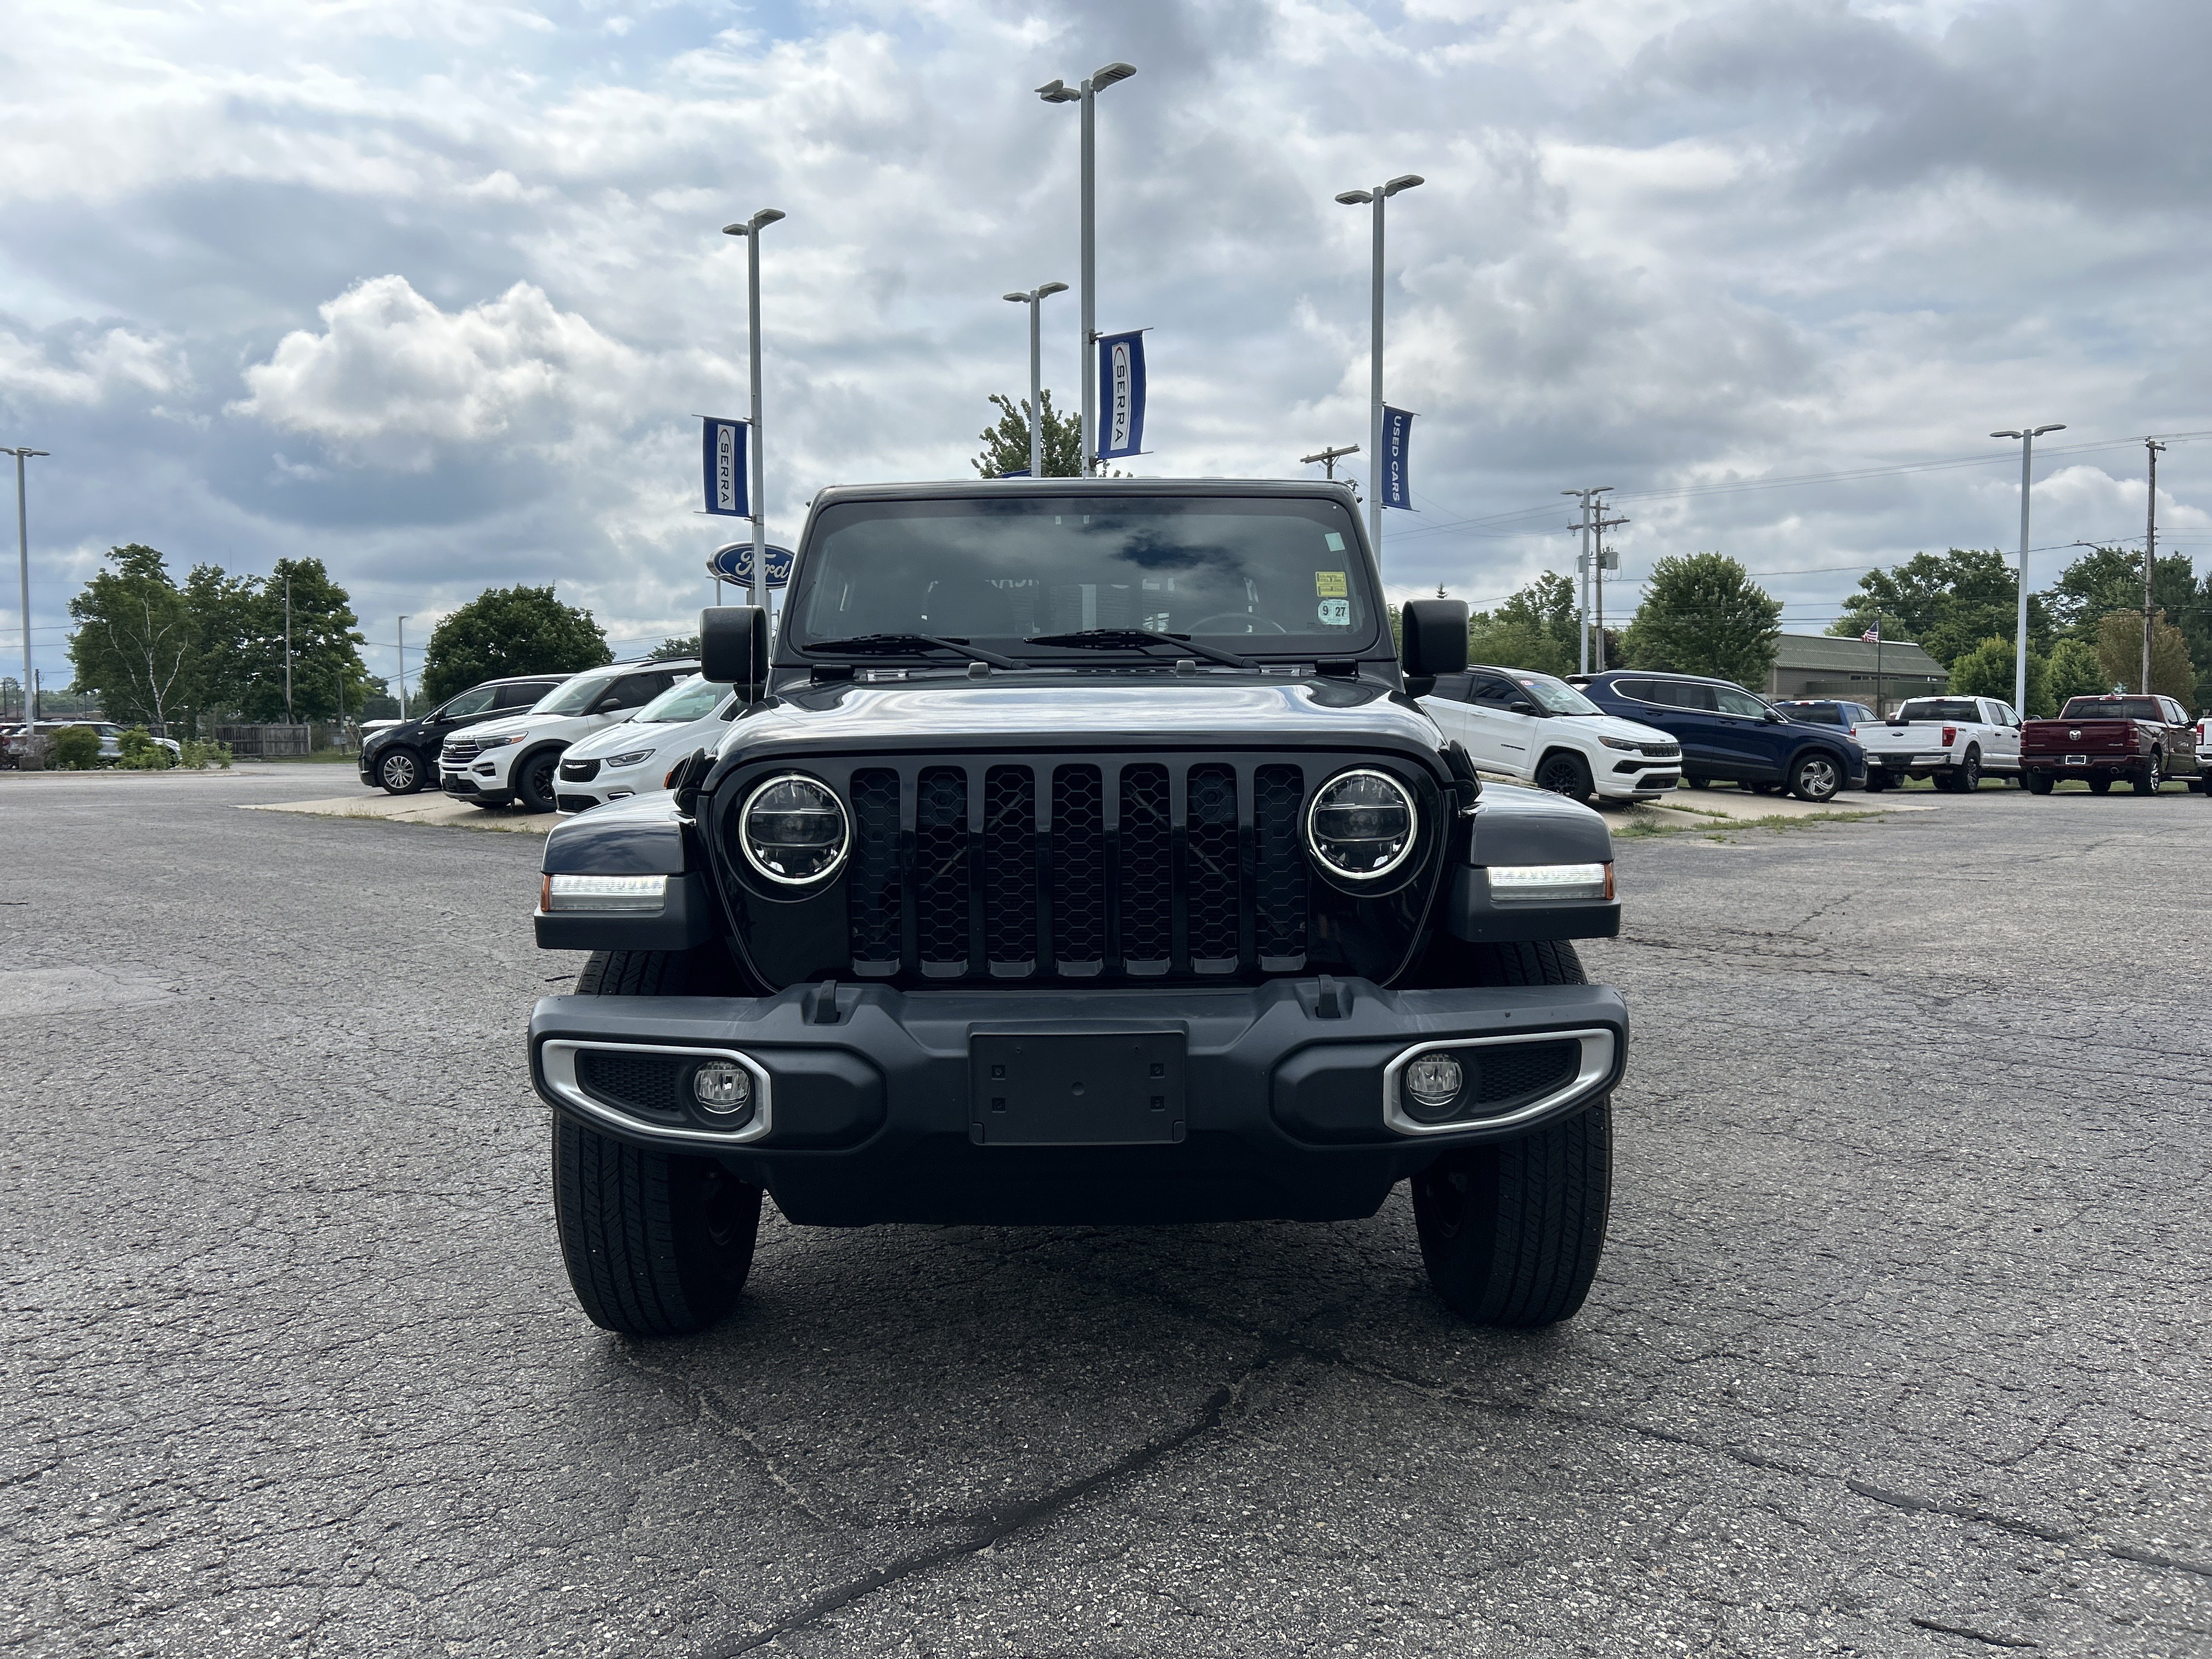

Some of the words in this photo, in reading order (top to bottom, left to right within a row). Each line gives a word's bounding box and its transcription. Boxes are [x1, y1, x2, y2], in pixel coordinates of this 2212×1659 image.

[1115, 365, 1125, 442] SERRA
[1392, 415, 1402, 457] USED
[721, 443, 729, 503] SERRA
[1391, 461, 1400, 501] CARS
[1322, 605, 1329, 616] 9
[1335, 606, 1346, 617] 27
